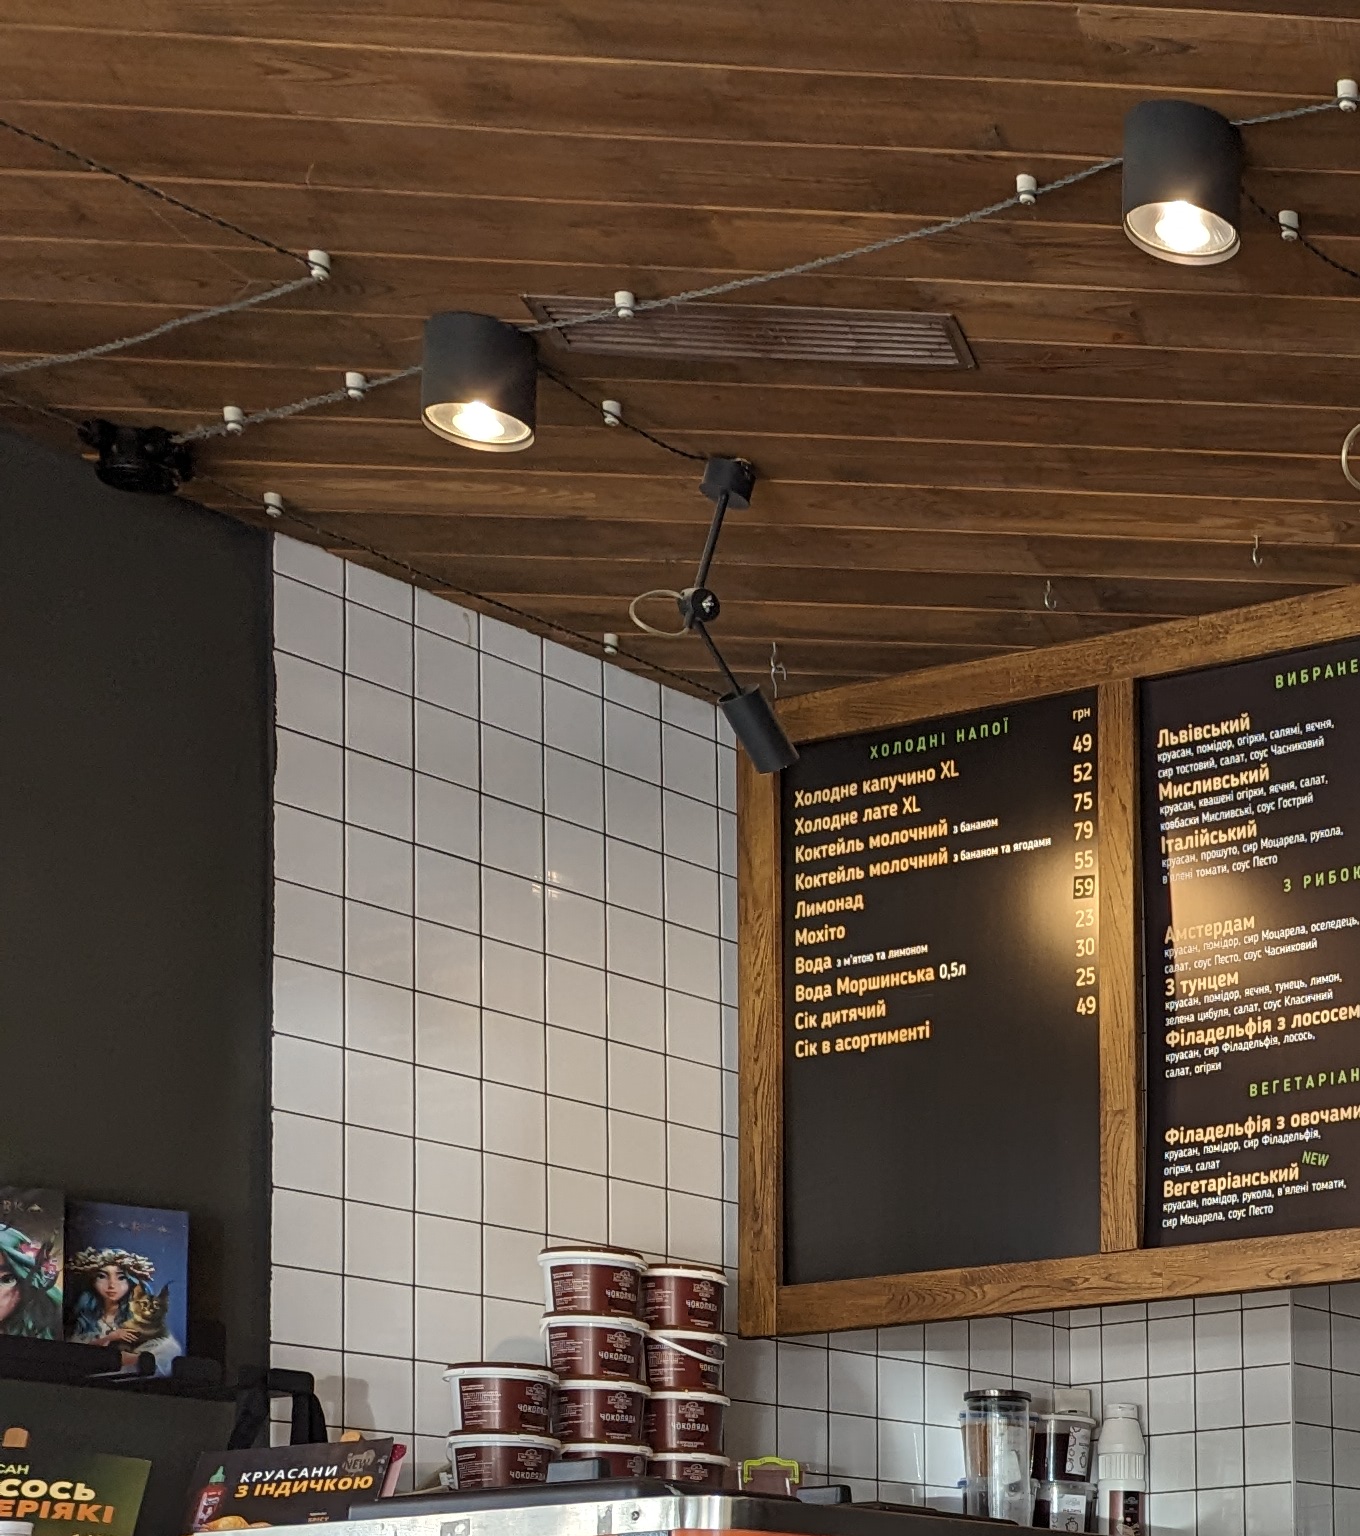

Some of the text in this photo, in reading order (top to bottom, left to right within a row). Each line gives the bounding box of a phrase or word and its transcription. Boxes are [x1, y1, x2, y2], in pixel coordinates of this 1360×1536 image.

[1275, 658, 1359, 689] ВИБРАНЕ
[870, 718, 1009, 759] ХОЛОДНІ НАПОЇ
[1073, 735, 1092, 753] 49
[1157, 712, 1250, 748] Львівський
[1157, 718, 1334, 763] круасан, помідор, огірки, салямі, яєчня,
[794, 761, 959, 808] Холодне капучино XL
[1159, 763, 1270, 801] Мисливський
[795, 838, 864, 863] Коктейль
[869, 821, 948, 849] молочний
[960, 818, 998, 833] бананом
[795, 954, 832, 974] Вода
[876, 951, 886, 960] та
[888, 944, 928, 959] лимоном
[1166, 1005, 1360, 1048] Філадельфія з лососем
[1302, 1151, 1329, 1167] NEW
[1163, 1164, 1299, 1198] Вегетаріанський
[240, 1465, 338, 1483] КРУАСАНИ
[253, 1475, 373, 1498] ІНДИЧКОЮ
